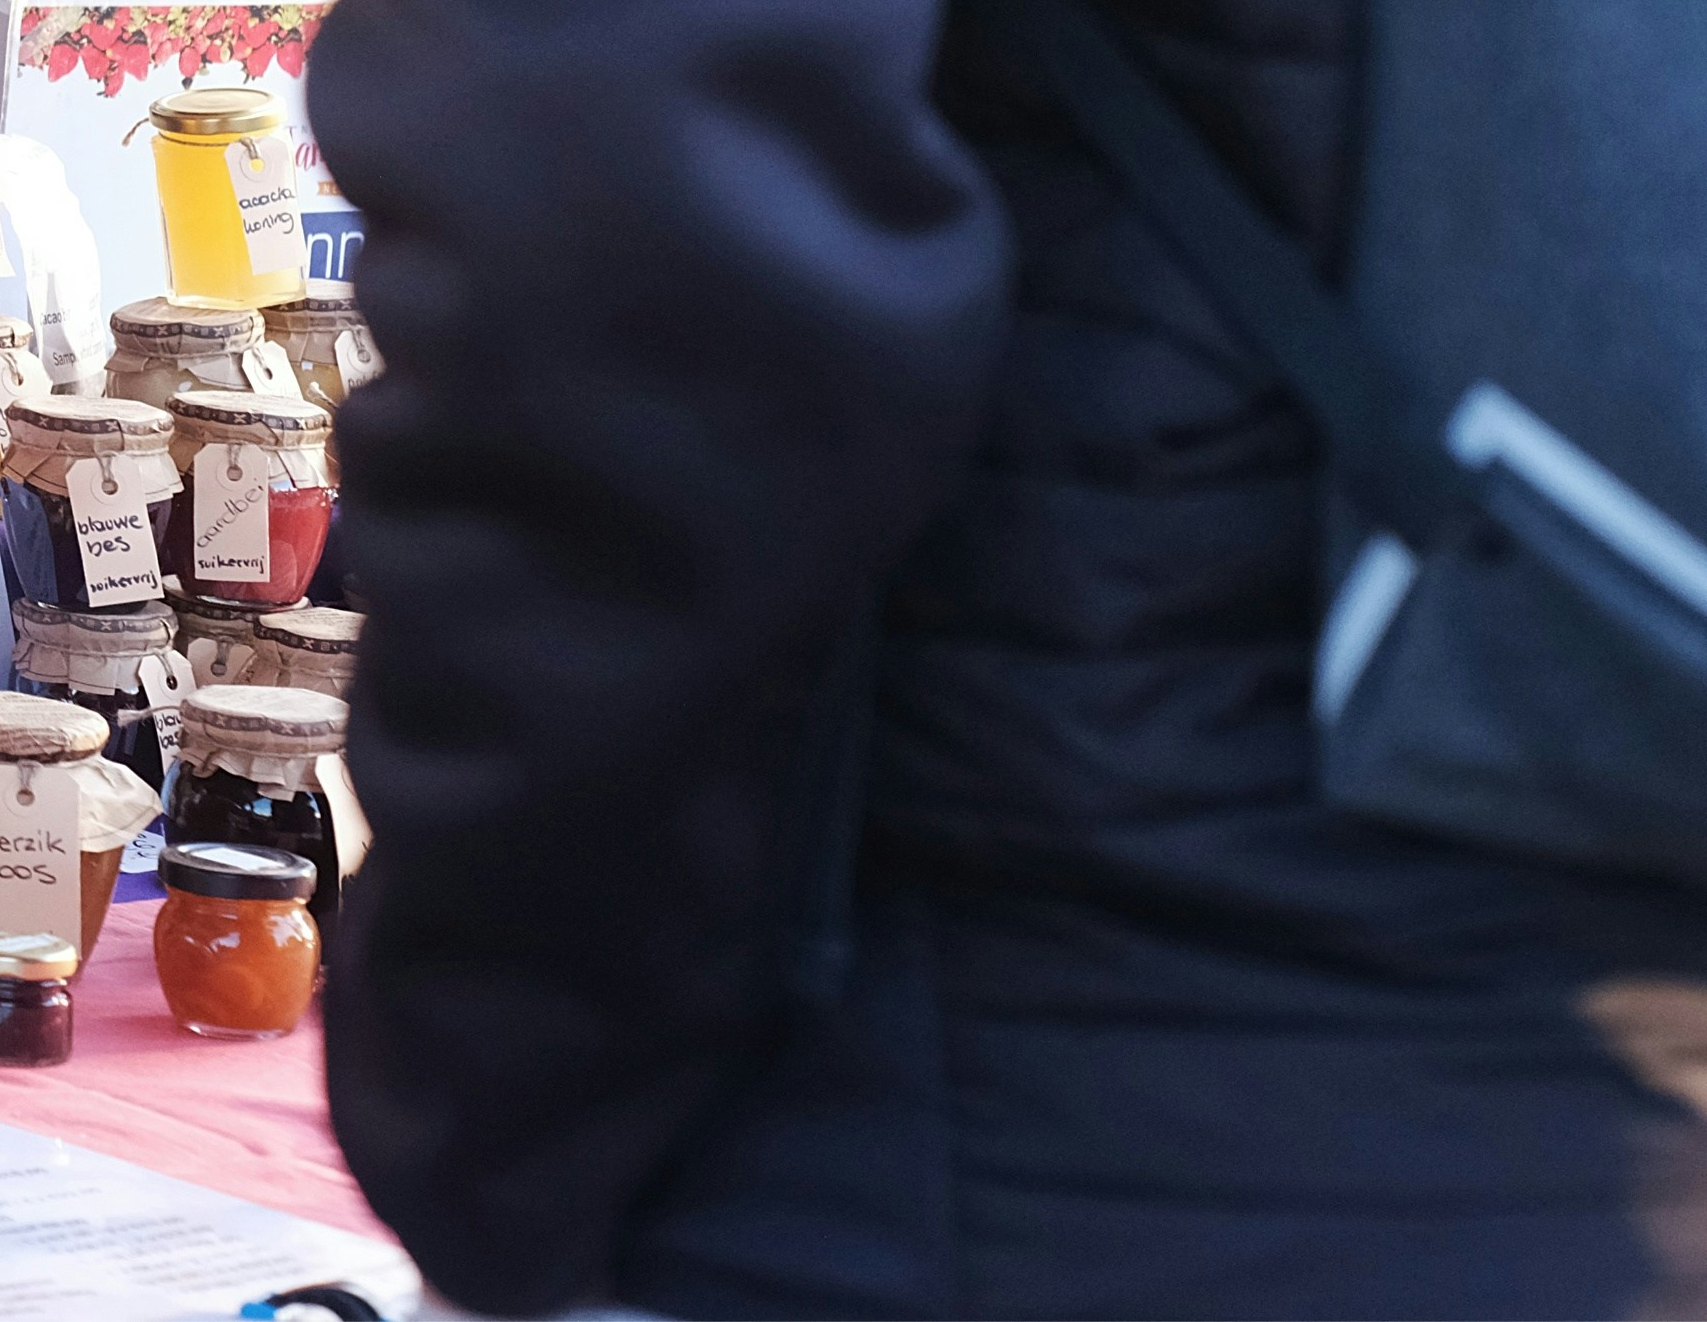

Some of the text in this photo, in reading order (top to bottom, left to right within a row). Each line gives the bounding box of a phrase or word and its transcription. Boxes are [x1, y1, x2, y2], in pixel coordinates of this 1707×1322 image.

[242, 212, 295, 235] honing
[197, 477, 266, 548] aardbei
[77, 513, 144, 536] blauwe
[86, 536, 132, 557] bes
